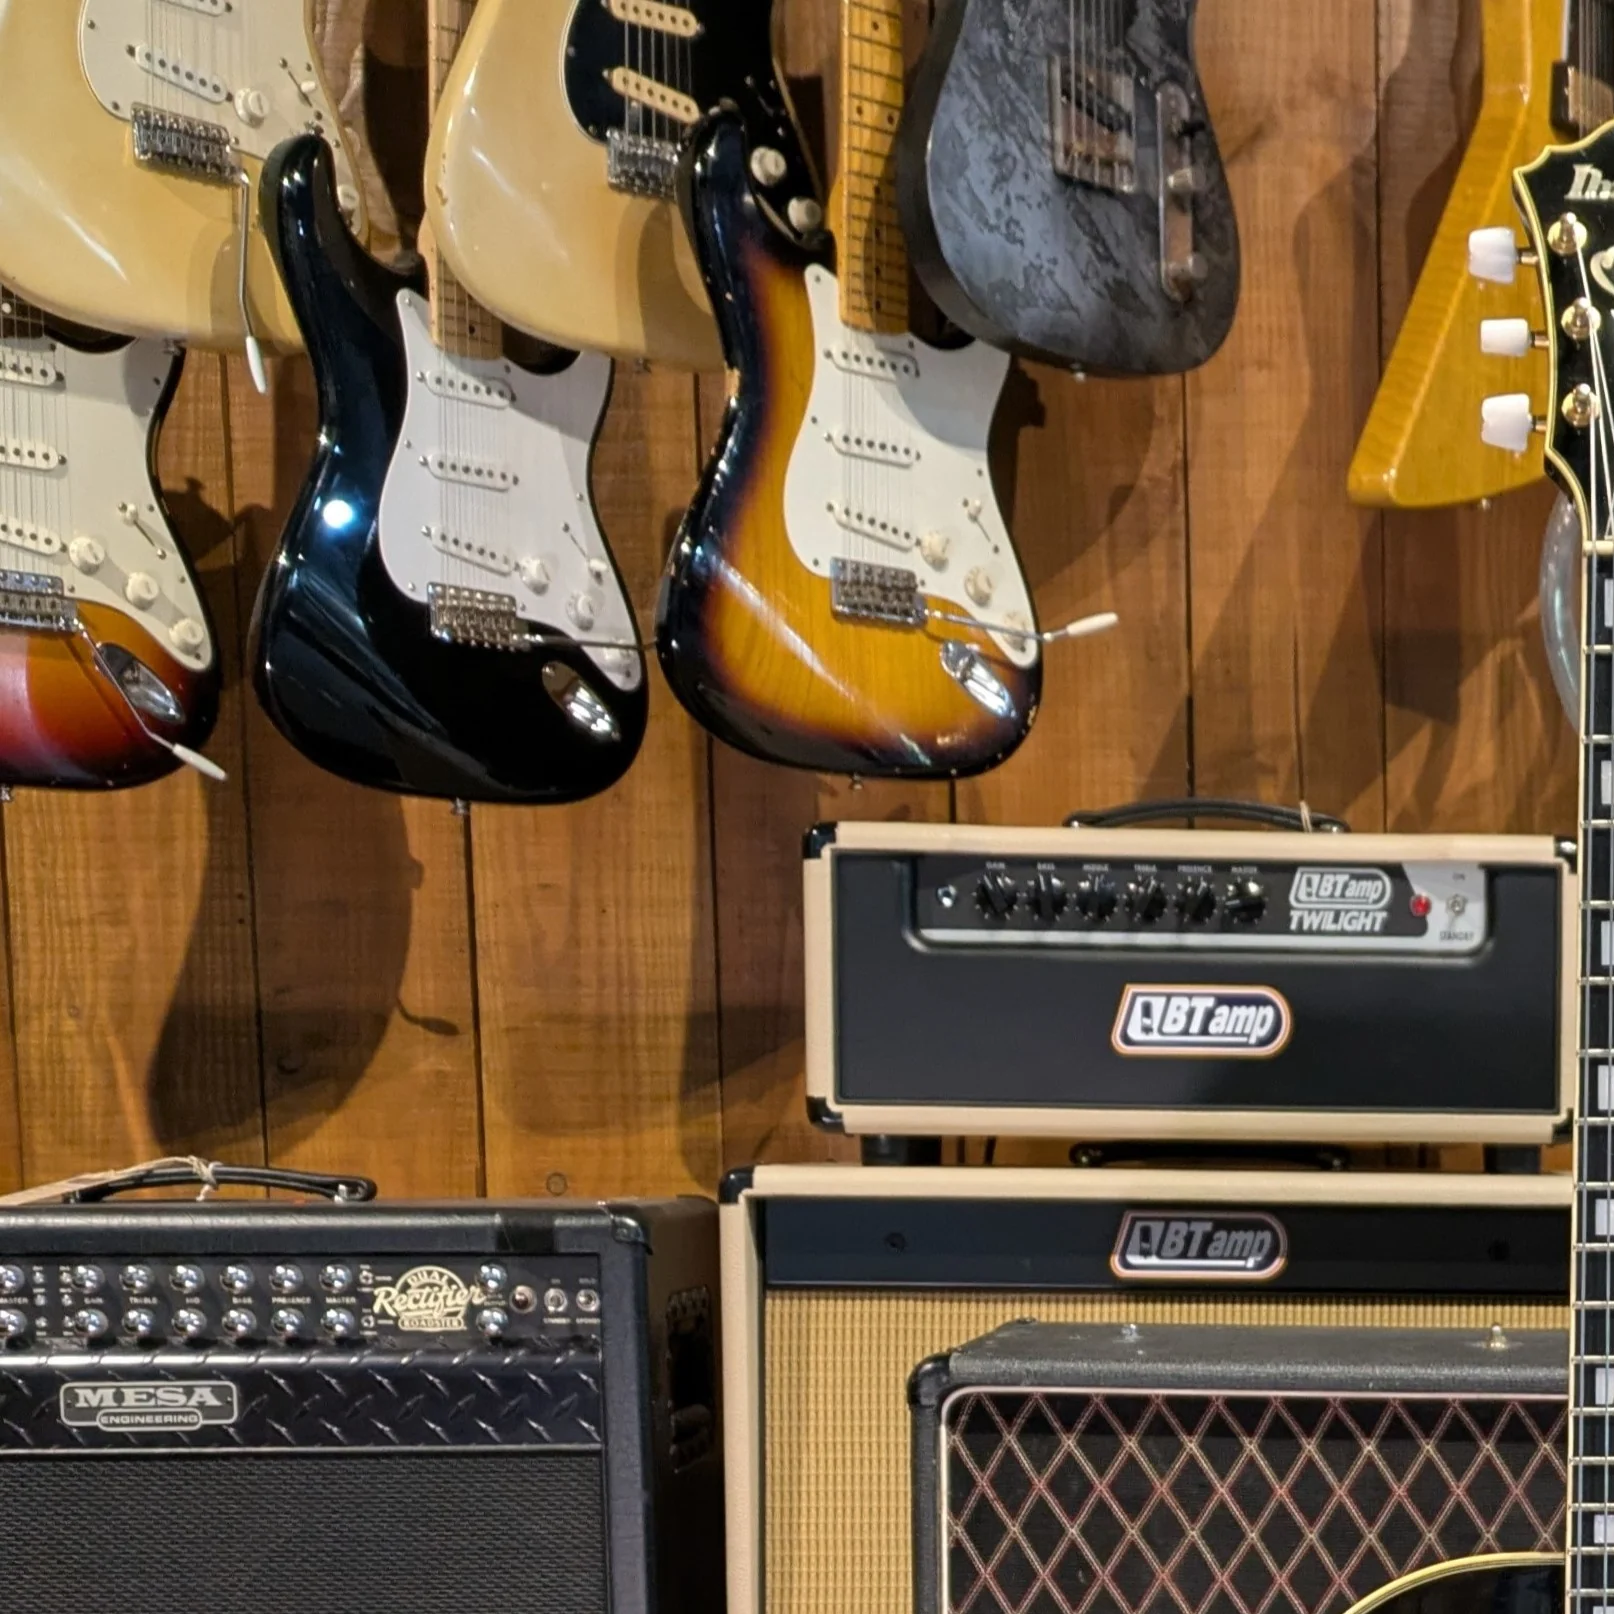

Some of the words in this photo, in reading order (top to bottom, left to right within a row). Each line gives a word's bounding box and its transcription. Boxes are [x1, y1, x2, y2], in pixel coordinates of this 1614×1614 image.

[1290, 911, 1388, 932] TWILIGHT
[407, 1270, 450, 1285] DUAL
[372, 1283, 487, 1319] Rectifier
[74, 1387, 223, 1408] MESA
[101, 1414, 199, 1424] ENGINEERING
